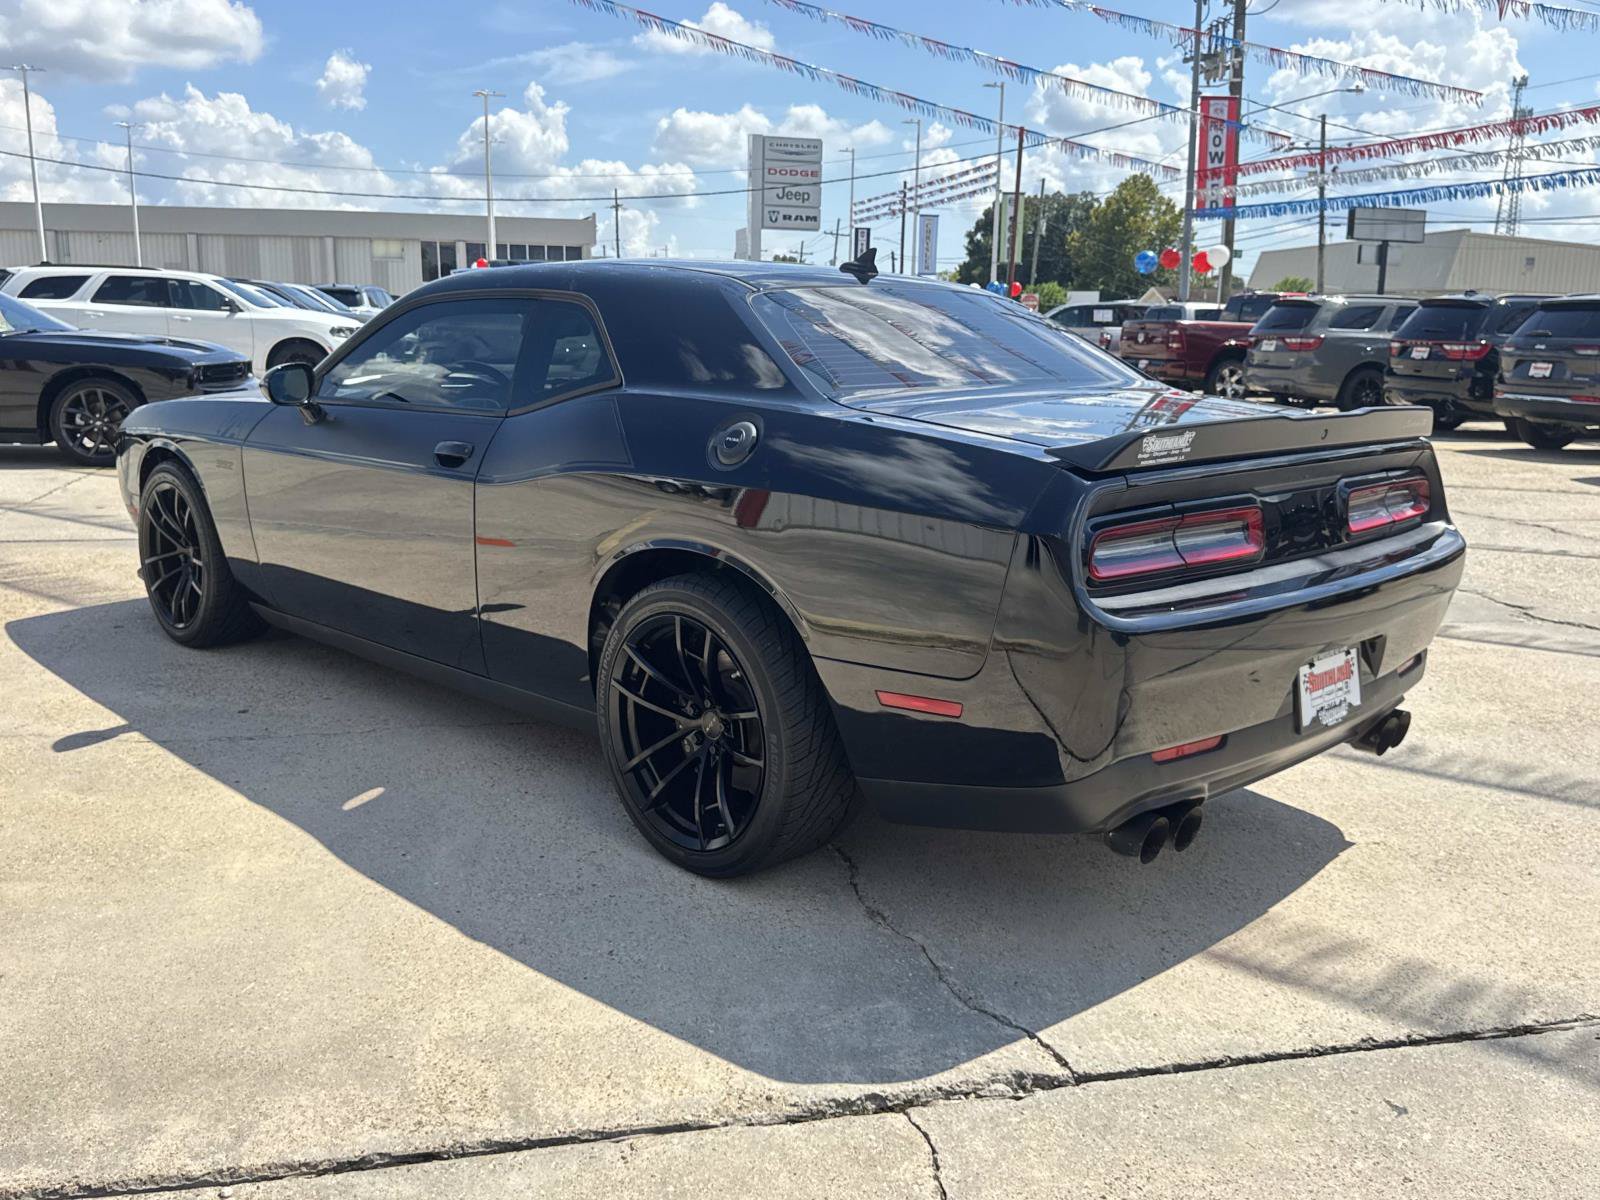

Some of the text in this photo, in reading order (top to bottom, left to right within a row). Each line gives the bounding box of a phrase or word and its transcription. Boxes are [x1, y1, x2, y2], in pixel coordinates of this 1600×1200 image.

[769, 142, 818, 150] CHRYSLER
[768, 168, 819, 177] DODGE
[776, 187, 811, 203] Jeep
[782, 214, 818, 222] RAM
